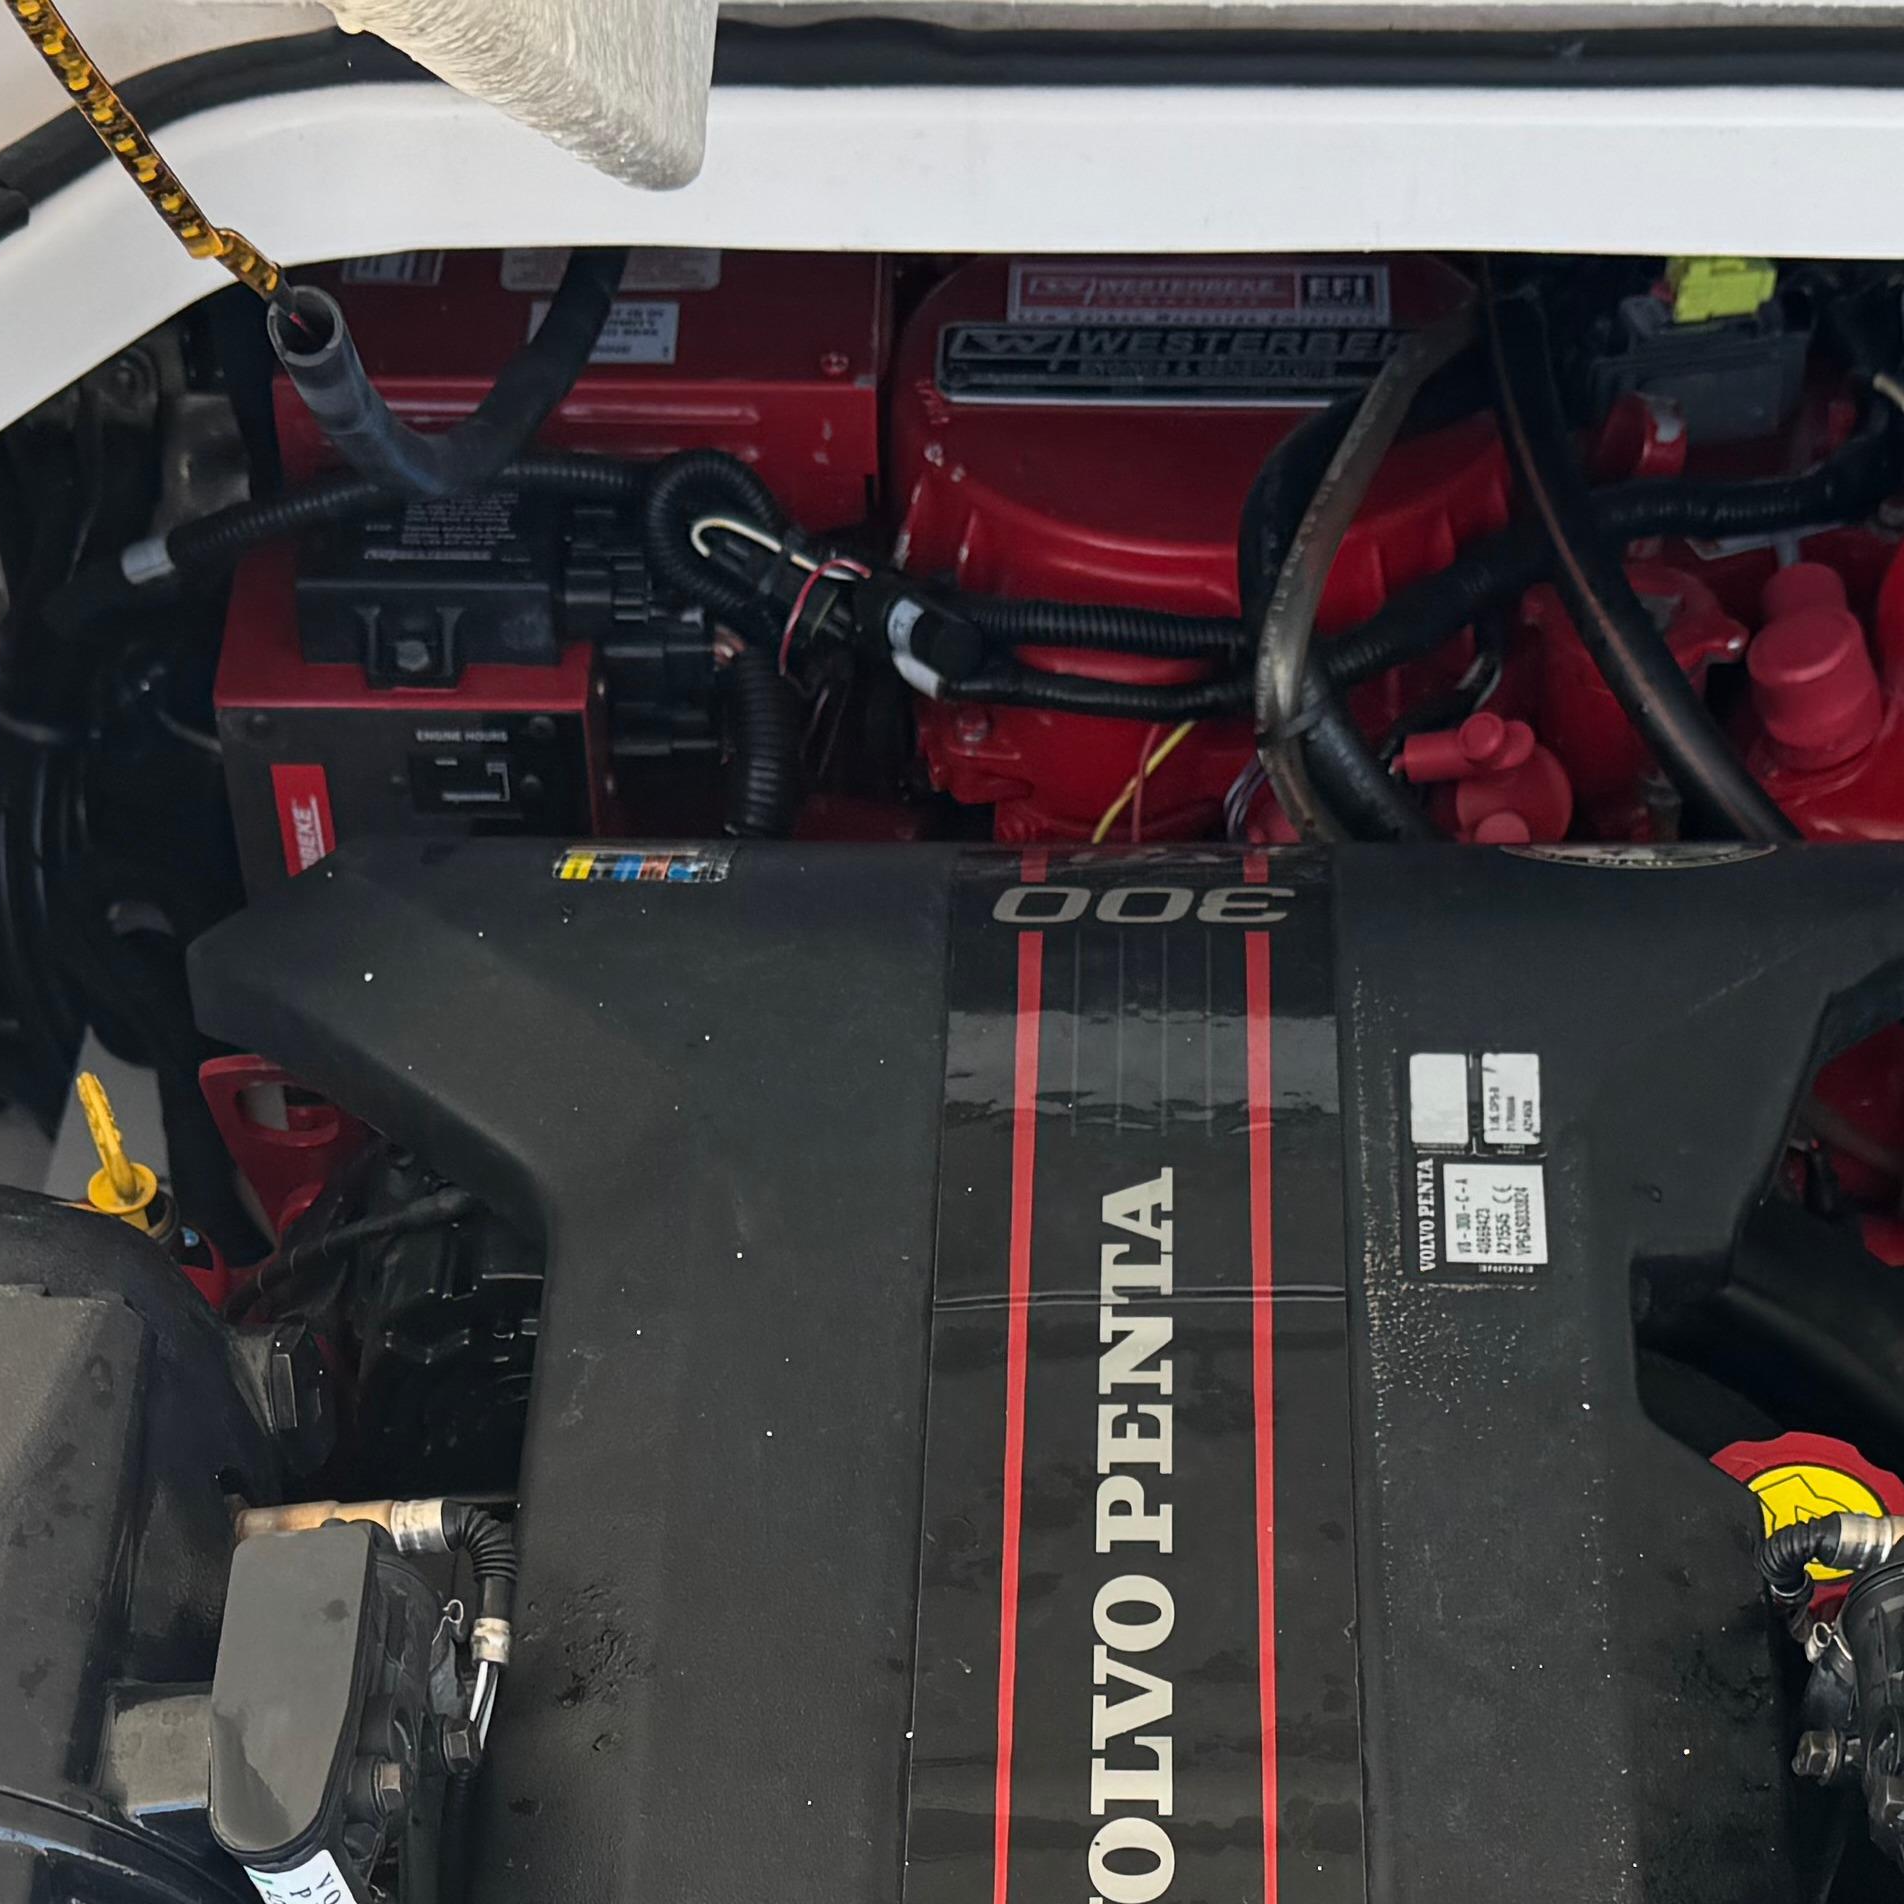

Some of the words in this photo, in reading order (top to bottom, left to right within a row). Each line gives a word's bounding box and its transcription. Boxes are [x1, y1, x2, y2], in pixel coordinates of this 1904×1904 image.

[993, 886, 1295, 924] 300
[1416, 1158, 1435, 1218] PENTA
[1419, 1219, 1437, 1272] VOLVO
[1096, 1167, 1174, 1554] PENTA
